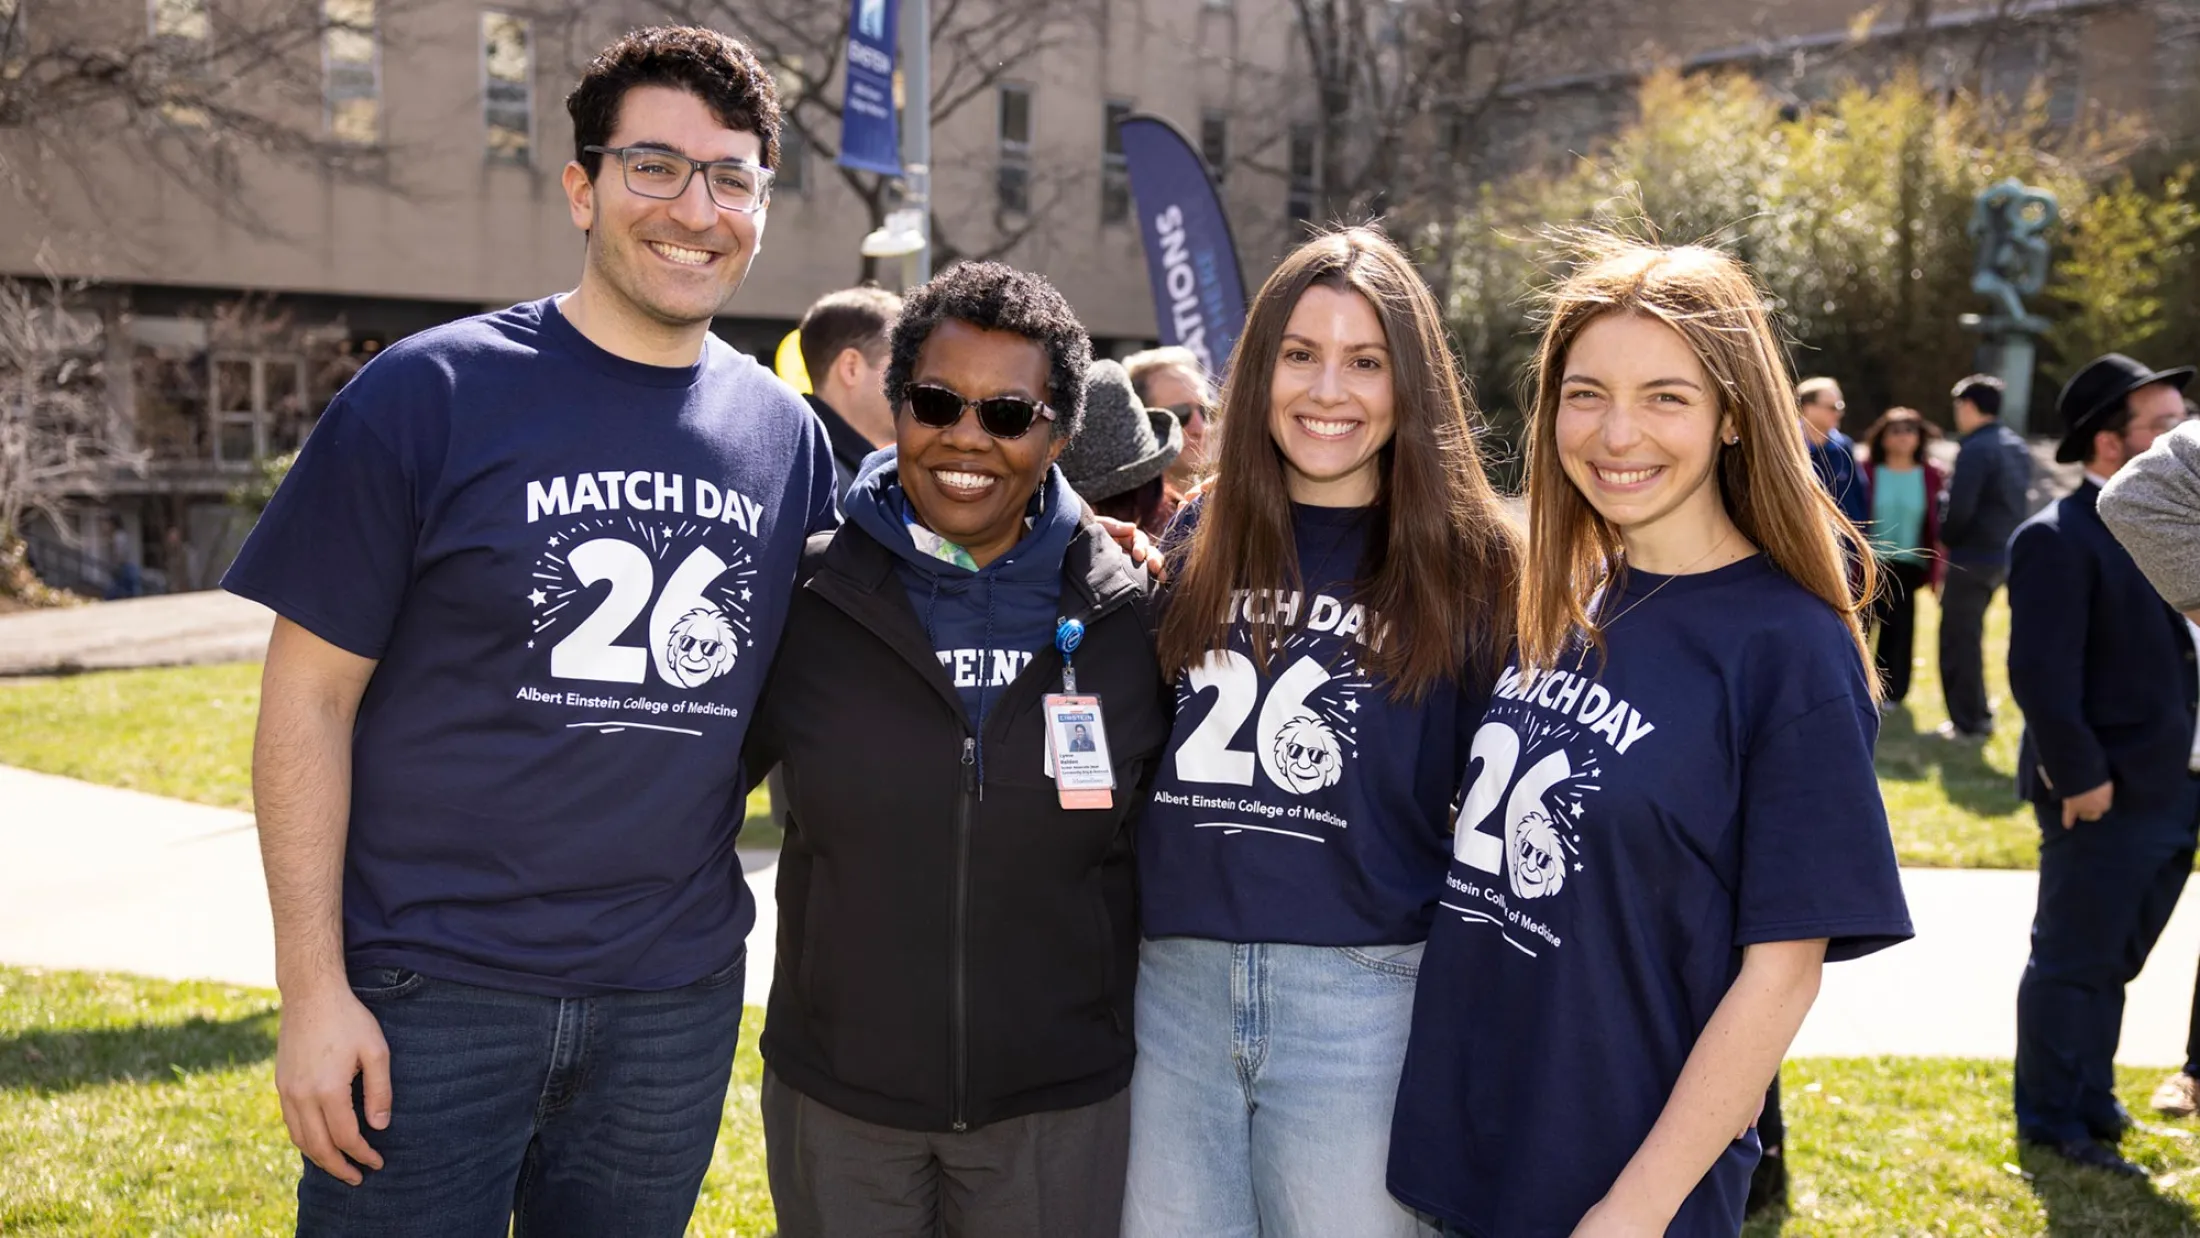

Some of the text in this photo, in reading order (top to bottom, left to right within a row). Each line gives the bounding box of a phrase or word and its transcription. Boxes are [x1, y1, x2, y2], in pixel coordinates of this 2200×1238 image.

[1155, 204, 1214, 384] ATIONS
[527, 470, 764, 538] MATCH DAY
[550, 537, 739, 690] 26
[1228, 588, 1301, 626] TCH
[516, 686, 739, 719] Albert Einstein College of Medicine
[1175, 648, 1344, 795] 26
[1493, 665, 1656, 756] MATCH DAY
[1154, 791, 1348, 829] Albert Einstein College of Medicine
[1453, 722, 1571, 900] 26
[1508, 910, 1521, 924] of
[1520, 914, 1561, 948] Medicine
